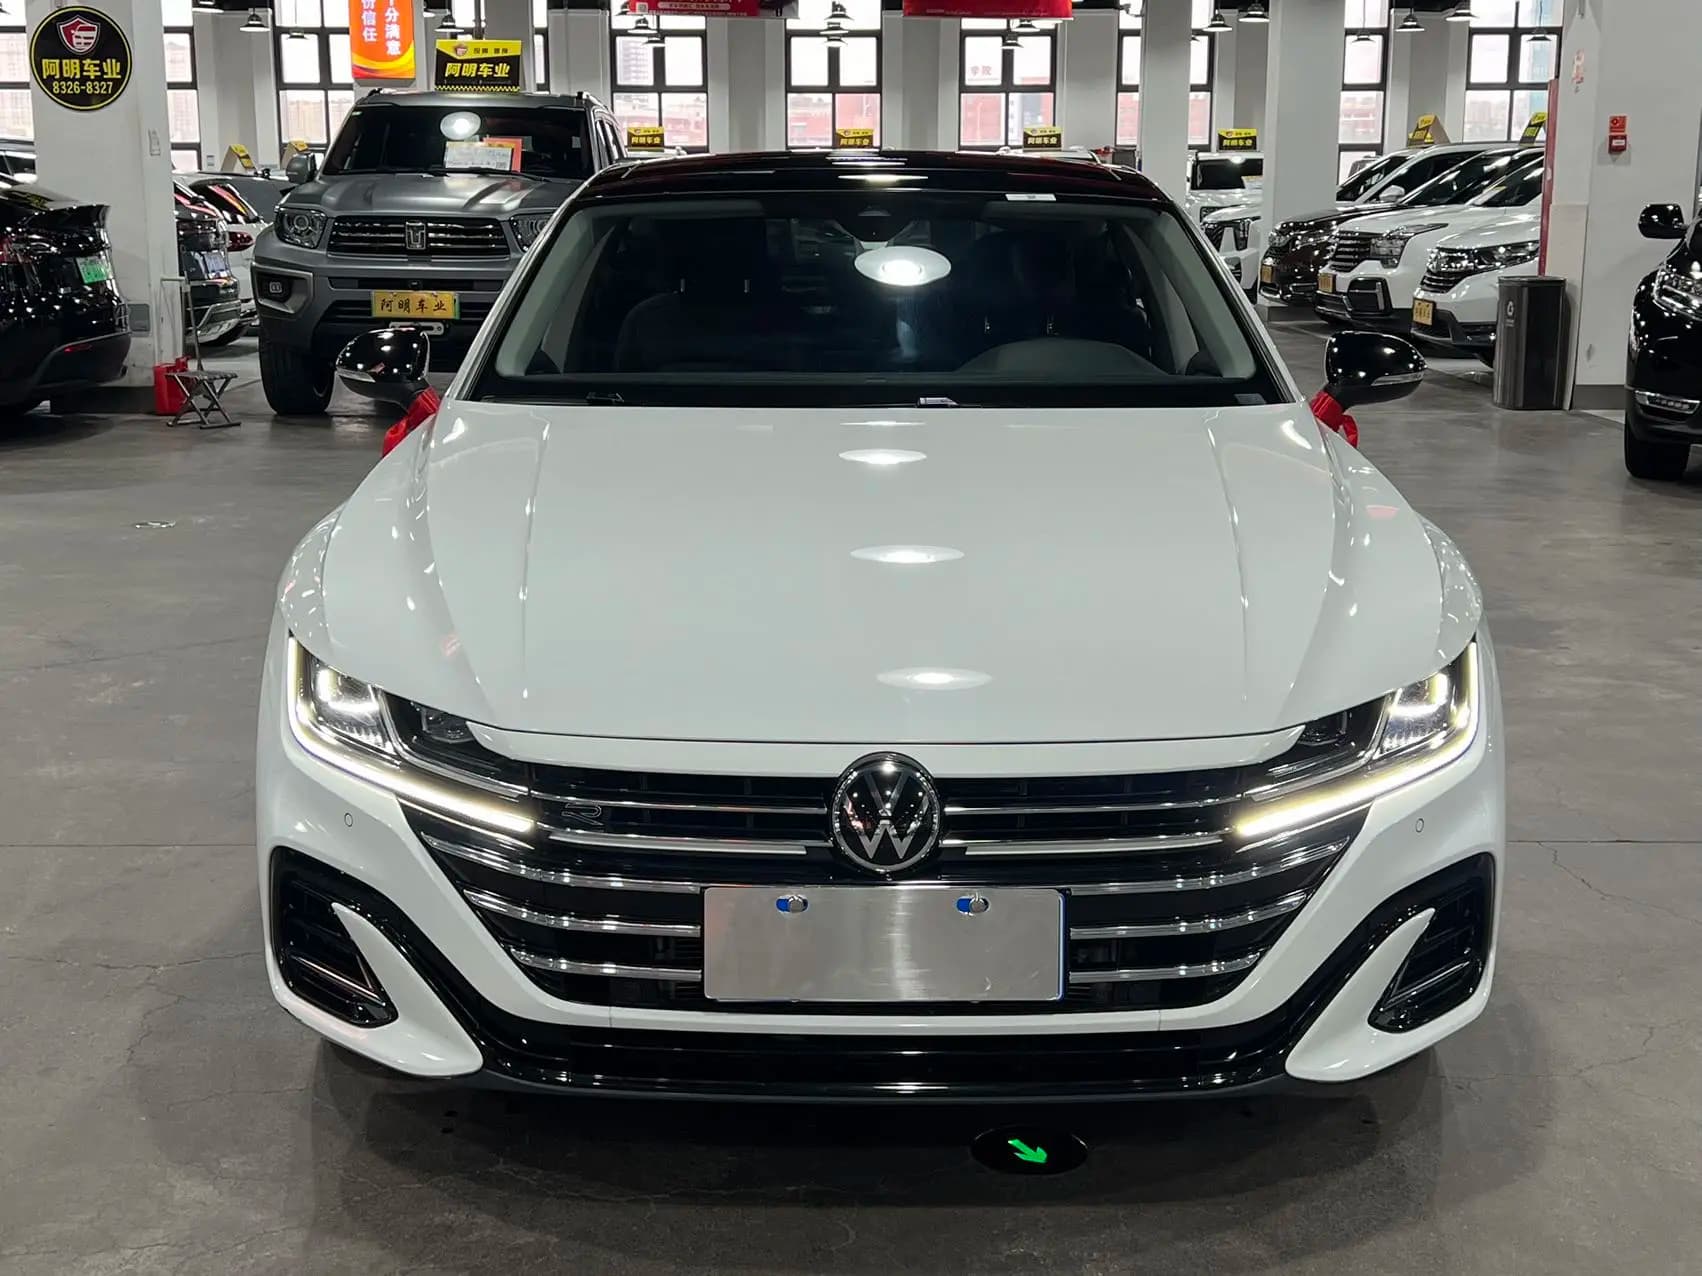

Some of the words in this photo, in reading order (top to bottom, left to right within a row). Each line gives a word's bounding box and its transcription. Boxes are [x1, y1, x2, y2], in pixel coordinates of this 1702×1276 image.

[41, 58, 122, 80] 阿明车业
[444, 62, 511, 78] 阿明车业
[52, 81, 114, 95] 8326-8327
[380, 298, 448, 314] 阿明车业
